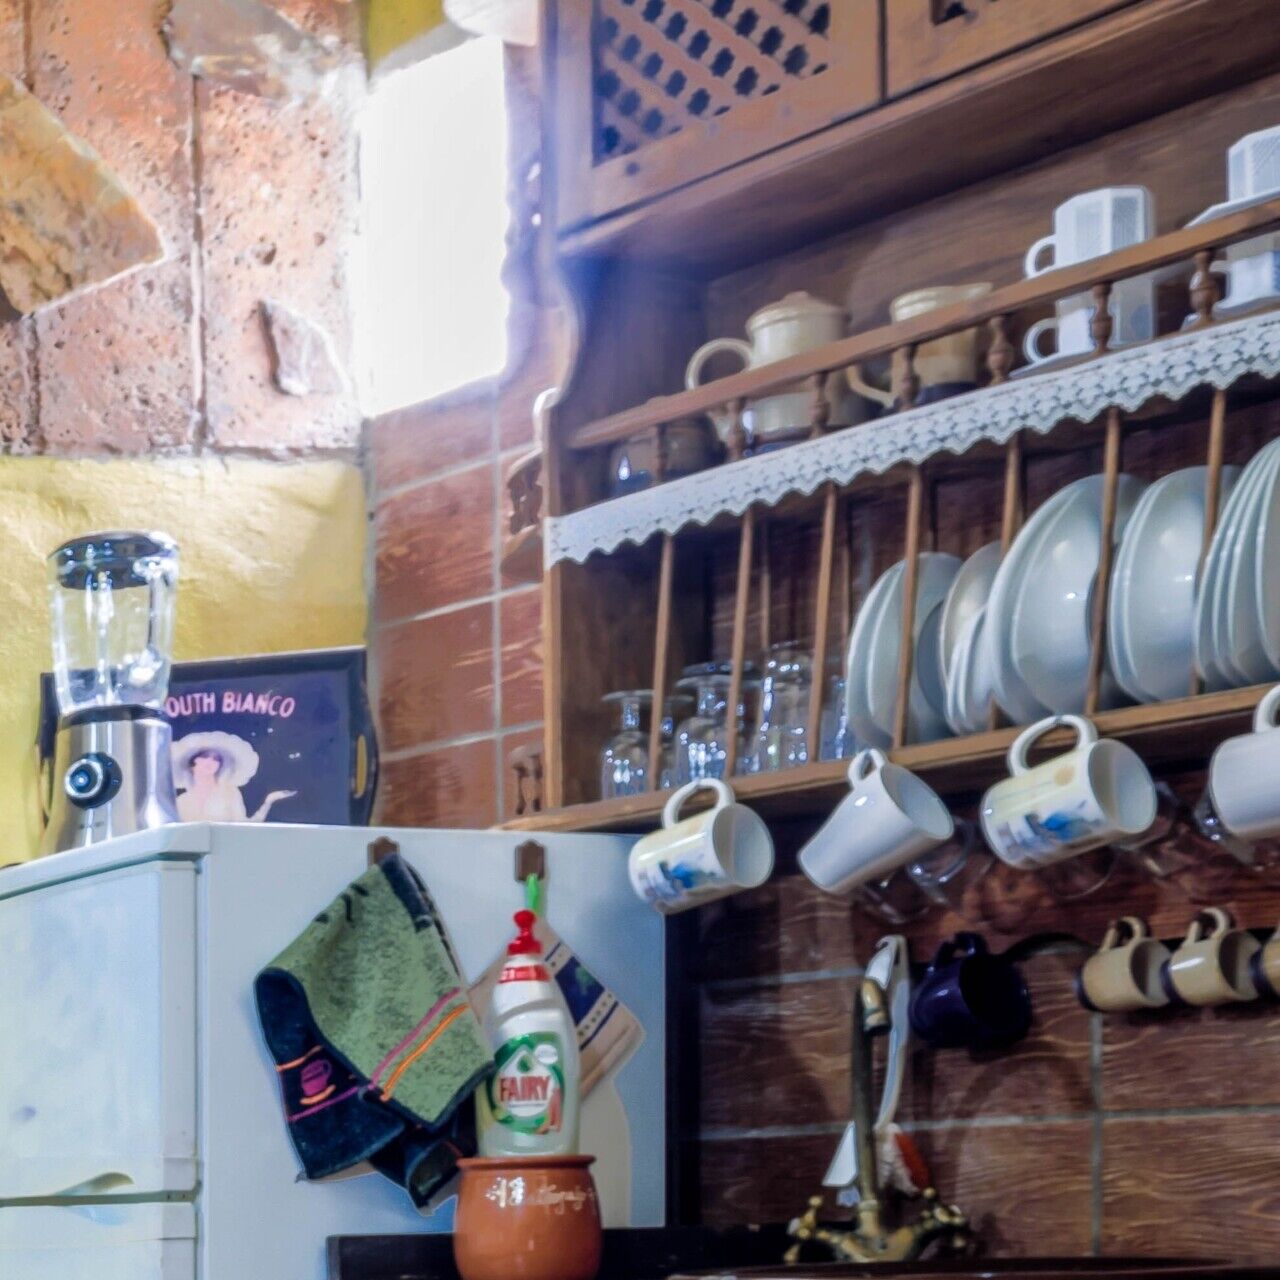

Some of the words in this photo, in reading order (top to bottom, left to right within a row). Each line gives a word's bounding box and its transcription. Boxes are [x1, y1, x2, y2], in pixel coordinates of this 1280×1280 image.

[166, 692, 216, 718] OUTH
[222, 691, 297, 718] BIANCO
[500, 1076, 550, 1102] FAIRY
